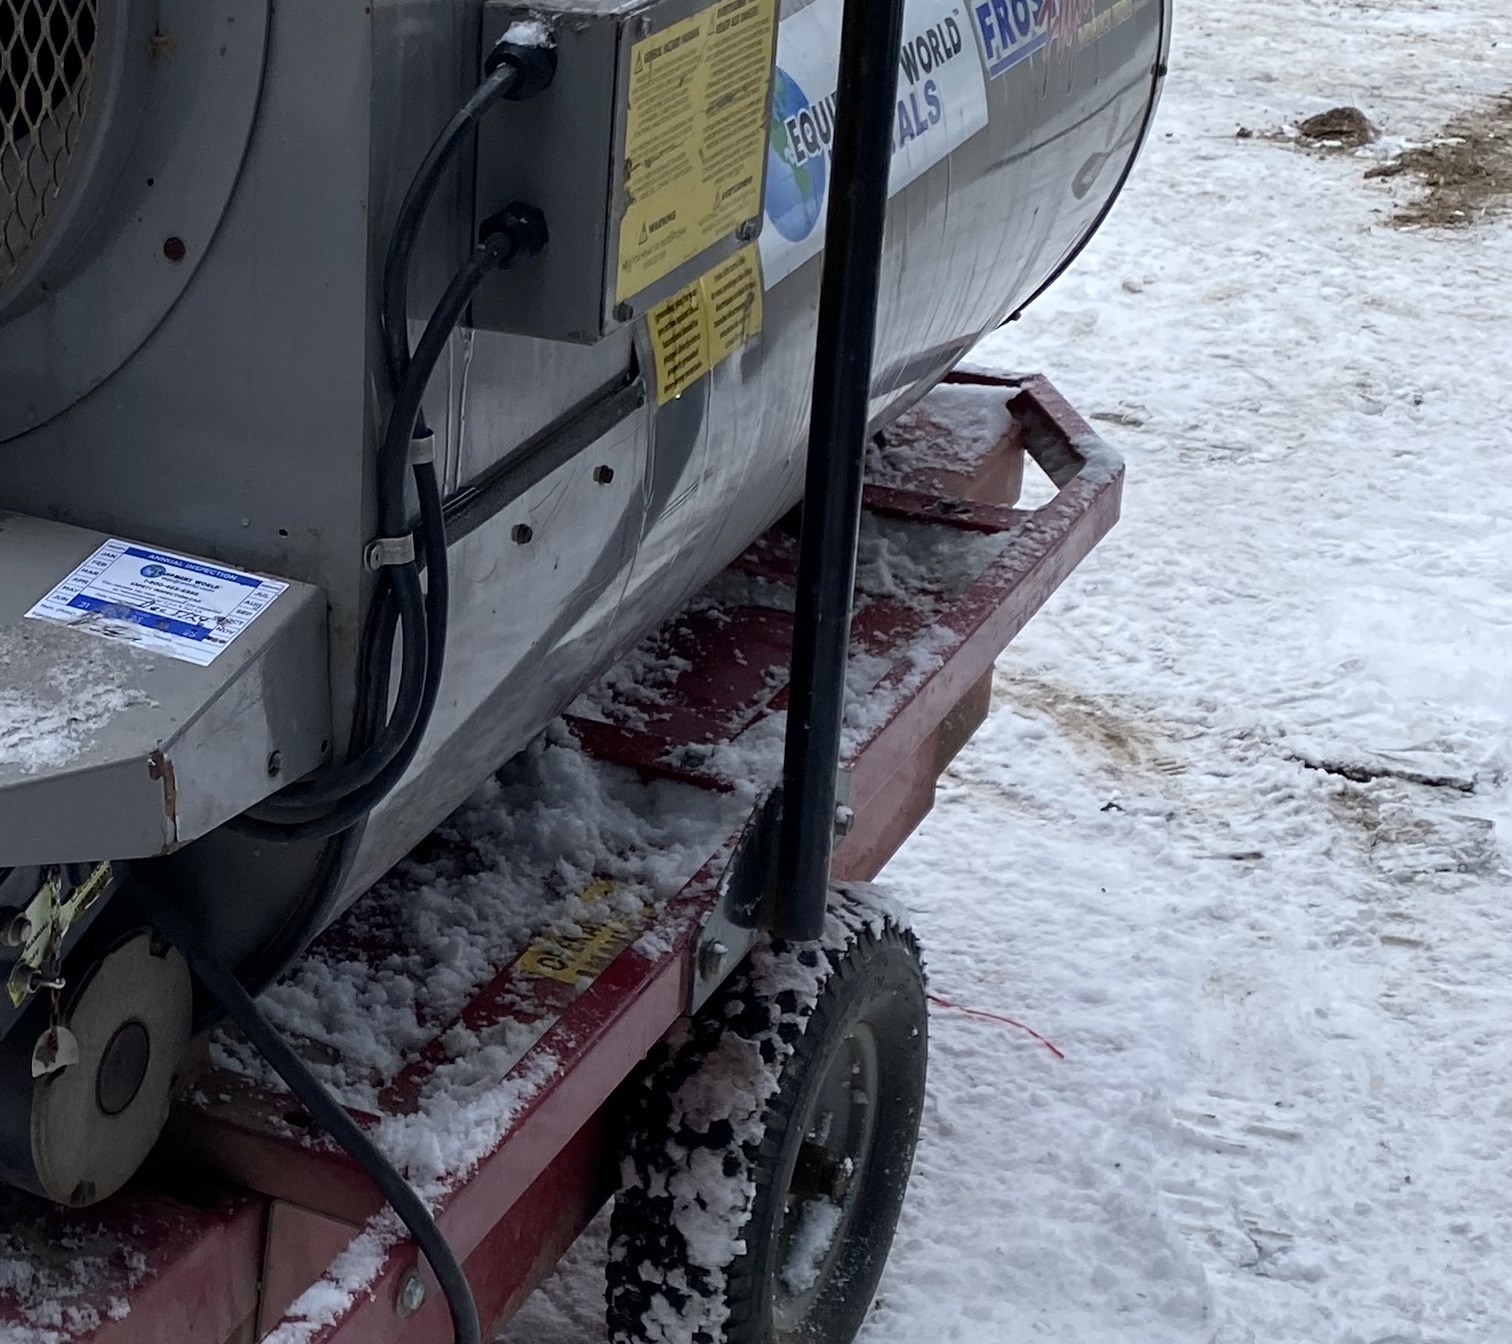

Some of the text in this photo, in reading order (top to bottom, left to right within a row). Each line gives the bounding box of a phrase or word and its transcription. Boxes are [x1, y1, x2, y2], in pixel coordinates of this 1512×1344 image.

[787, 17, 962, 164] EQUI WORLD
[893, 79, 941, 153] ALS
[89, 559, 108, 567] FEB
[147, 553, 238, 580] ANNUAL INSPECTION
[79, 567, 100, 575] MAR
[60, 585, 80, 593] MAY
[214, 626, 235, 635] NOV
